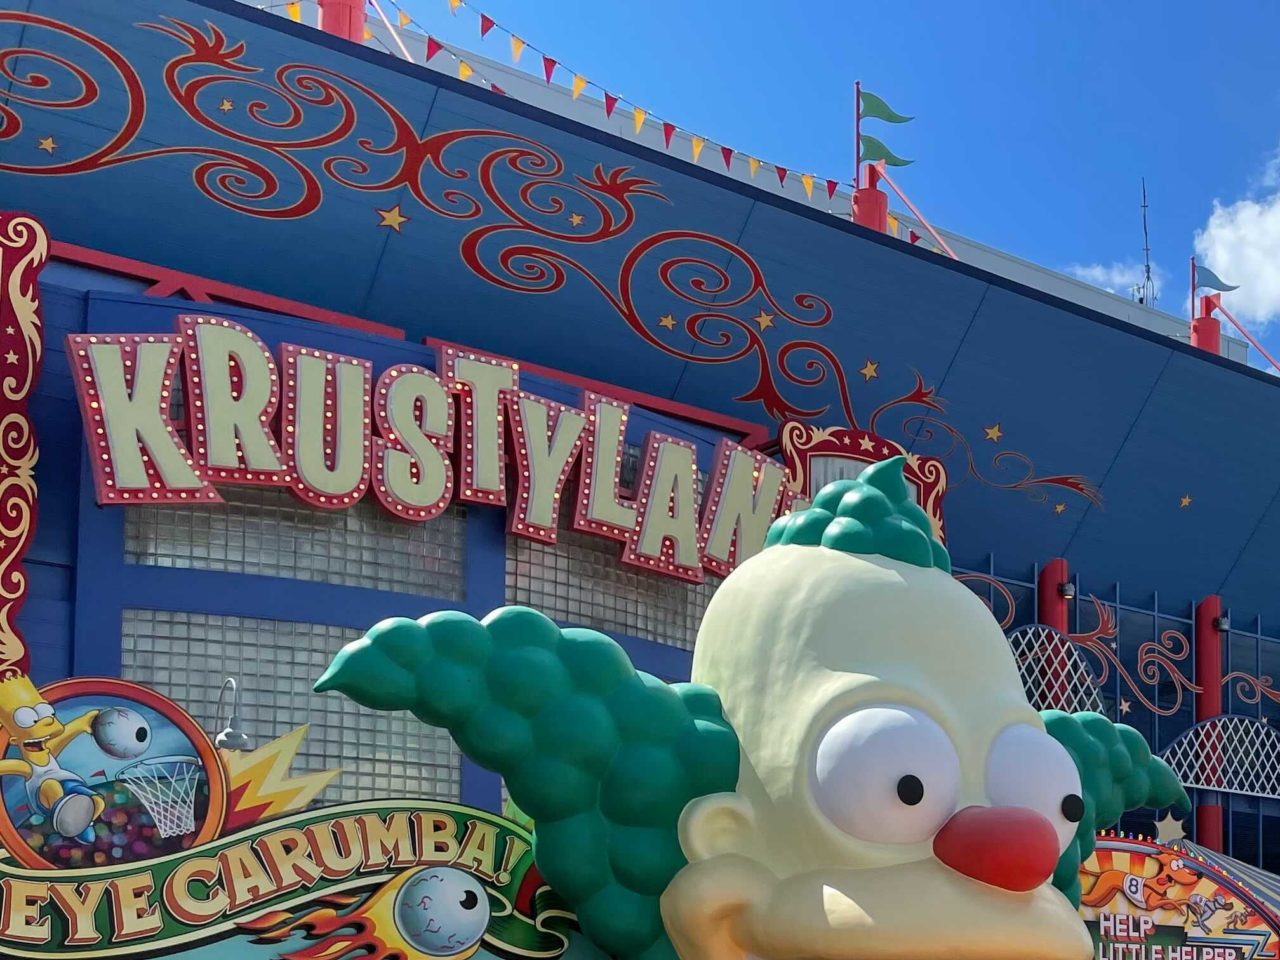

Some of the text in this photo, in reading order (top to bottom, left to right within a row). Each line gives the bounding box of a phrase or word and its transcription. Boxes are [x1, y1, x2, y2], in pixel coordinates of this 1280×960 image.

[76, 317, 811, 577] KRUSTYLAN
[0, 810, 531, 945] EYE CARUMBA!
[1100, 912, 1155, 941] HELP
